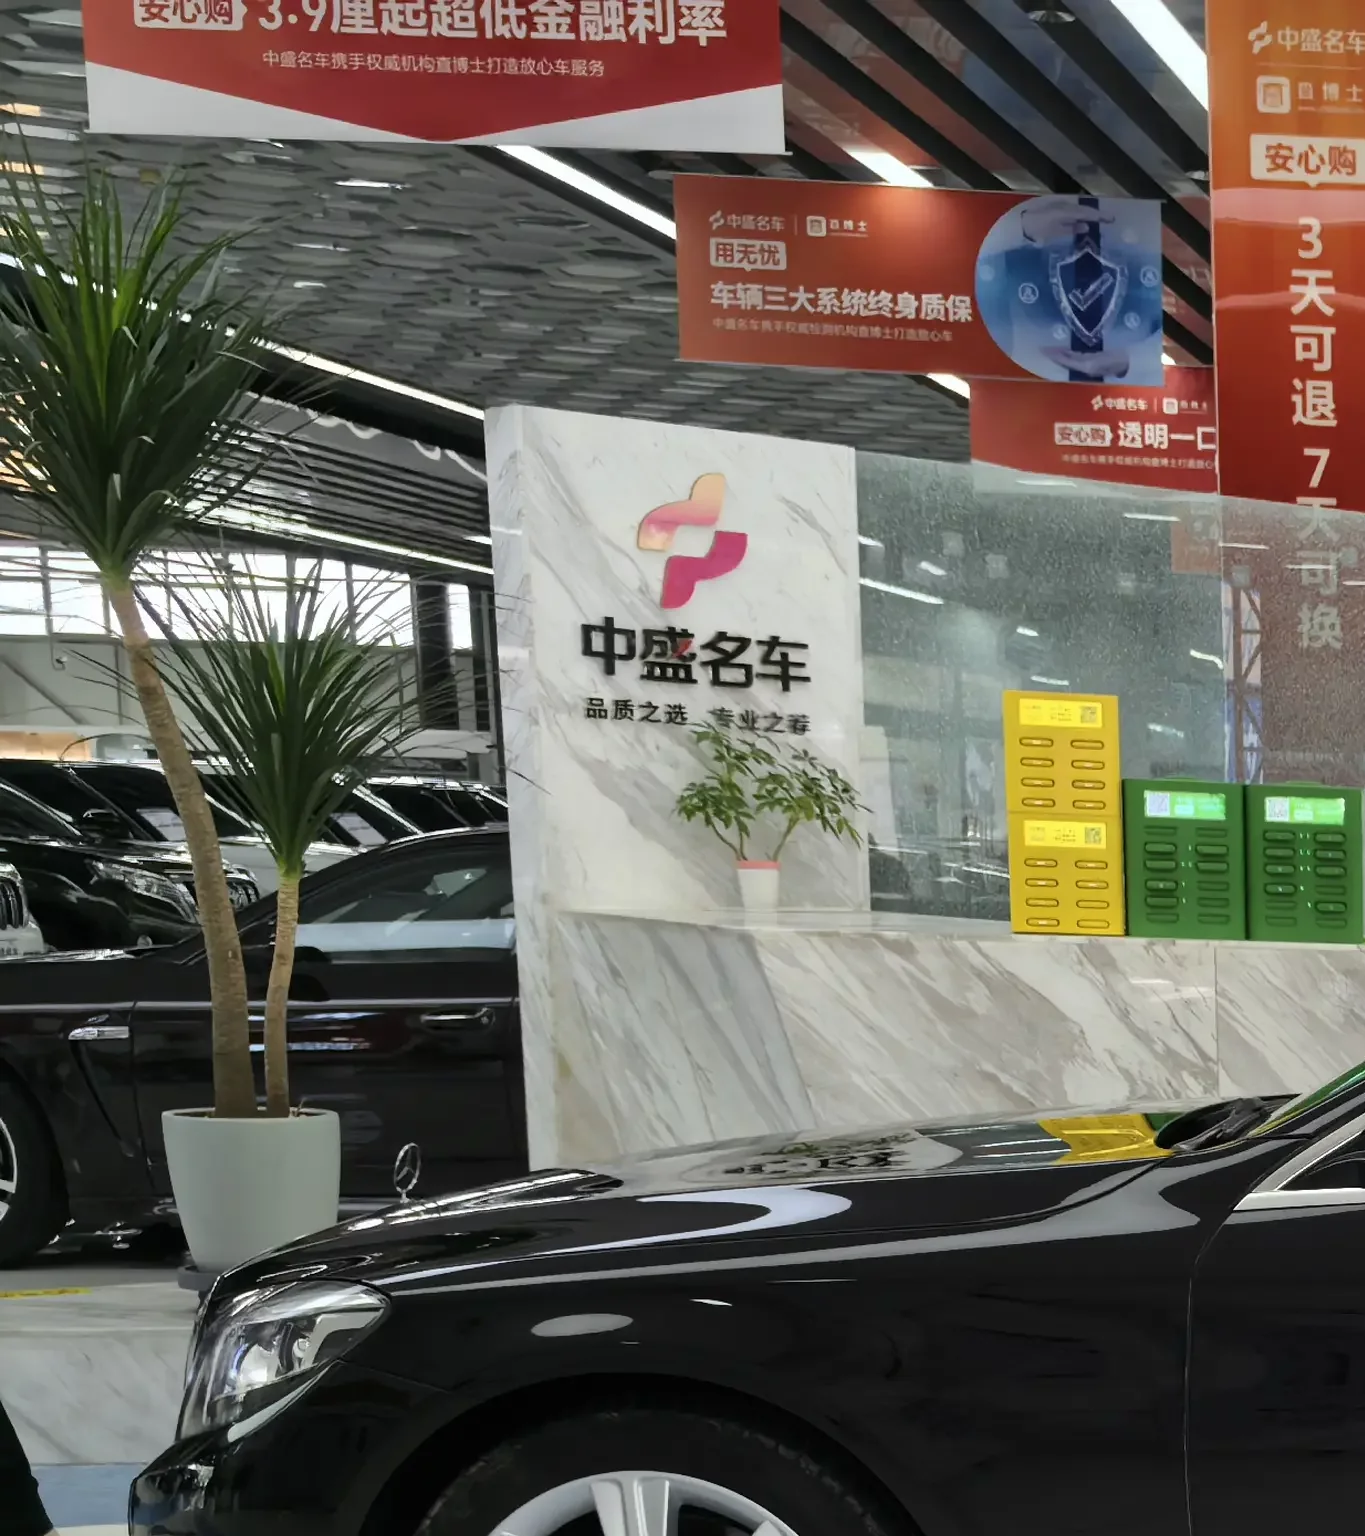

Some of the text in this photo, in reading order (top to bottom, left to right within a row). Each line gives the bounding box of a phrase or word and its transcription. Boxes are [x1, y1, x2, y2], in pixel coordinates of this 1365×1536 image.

[140, 0, 728, 47] 安心购 3.9厘起超低金融利率
[1265, 143, 1357, 177] 安心购
[726, 214, 785, 232] 中盛名车
[714, 242, 781, 266] 用无忧
[710, 281, 974, 323] 车辆三大系统终身质保
[1290, 217, 1339, 428] 3天可退
[580, 616, 811, 692] 中盛名车
[586, 697, 689, 726] 品质之选
